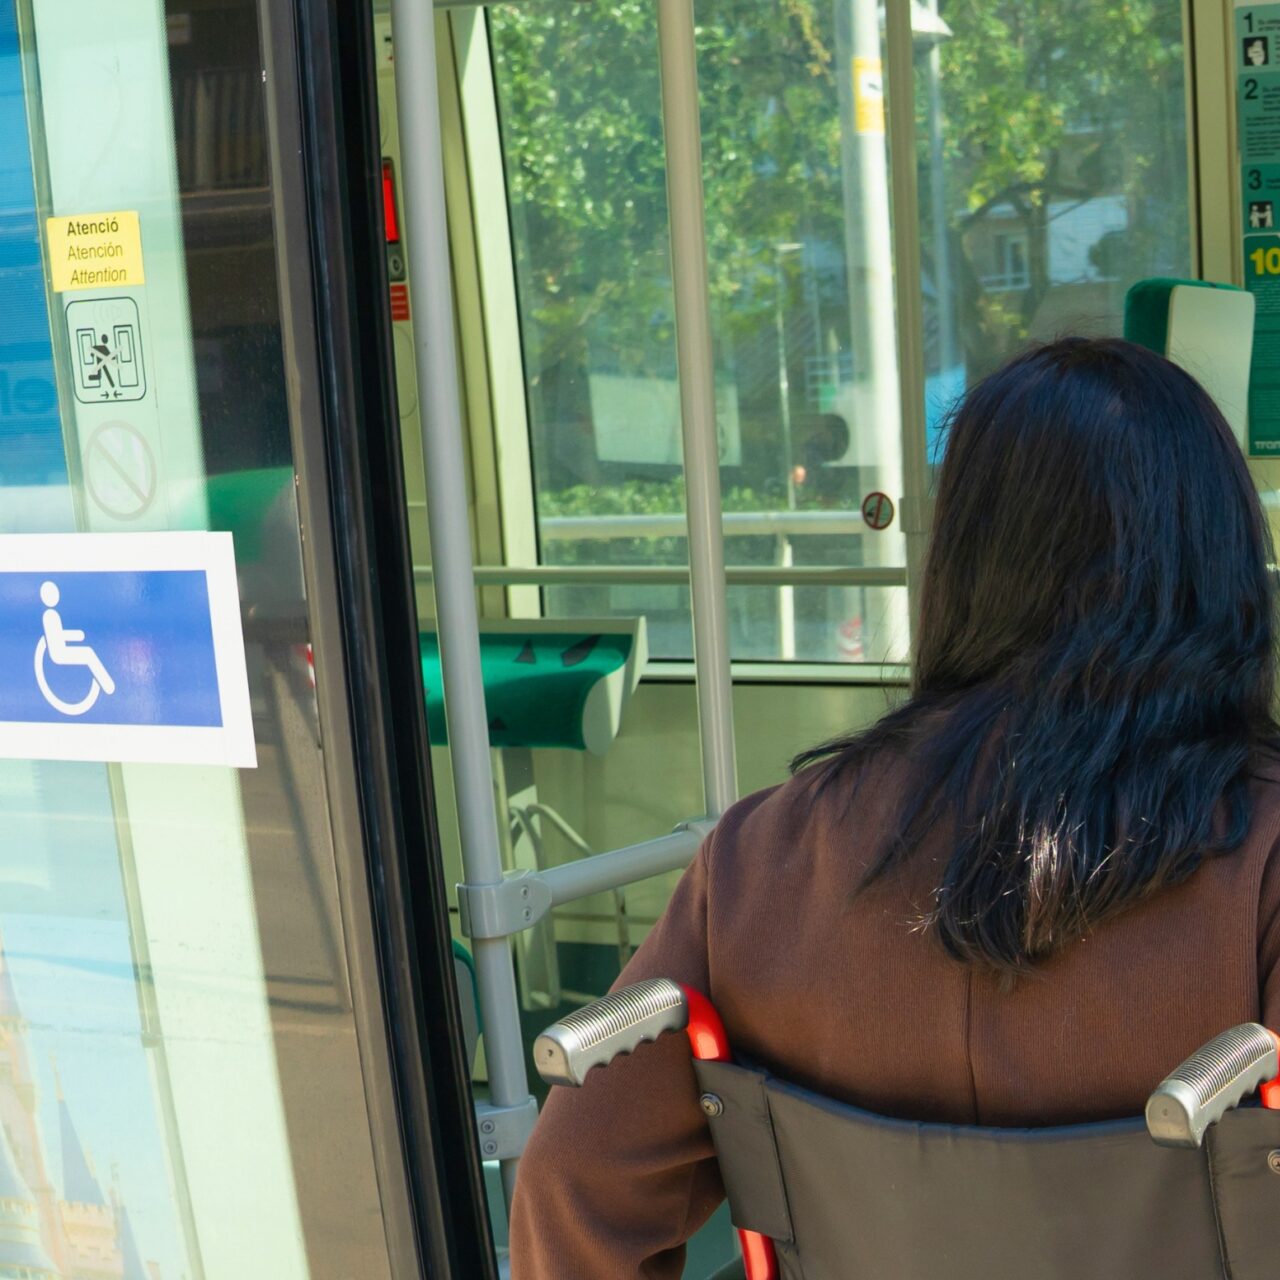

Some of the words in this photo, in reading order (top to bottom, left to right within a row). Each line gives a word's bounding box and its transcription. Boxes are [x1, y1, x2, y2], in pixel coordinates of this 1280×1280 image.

[1243, 11, 1253, 32] 1
[1244, 78, 1258, 100] 2
[1248, 169, 1263, 190] 3
[67, 217, 119, 236] Atenció
[67, 242, 123, 260] Atención
[70, 267, 127, 285] Attention
